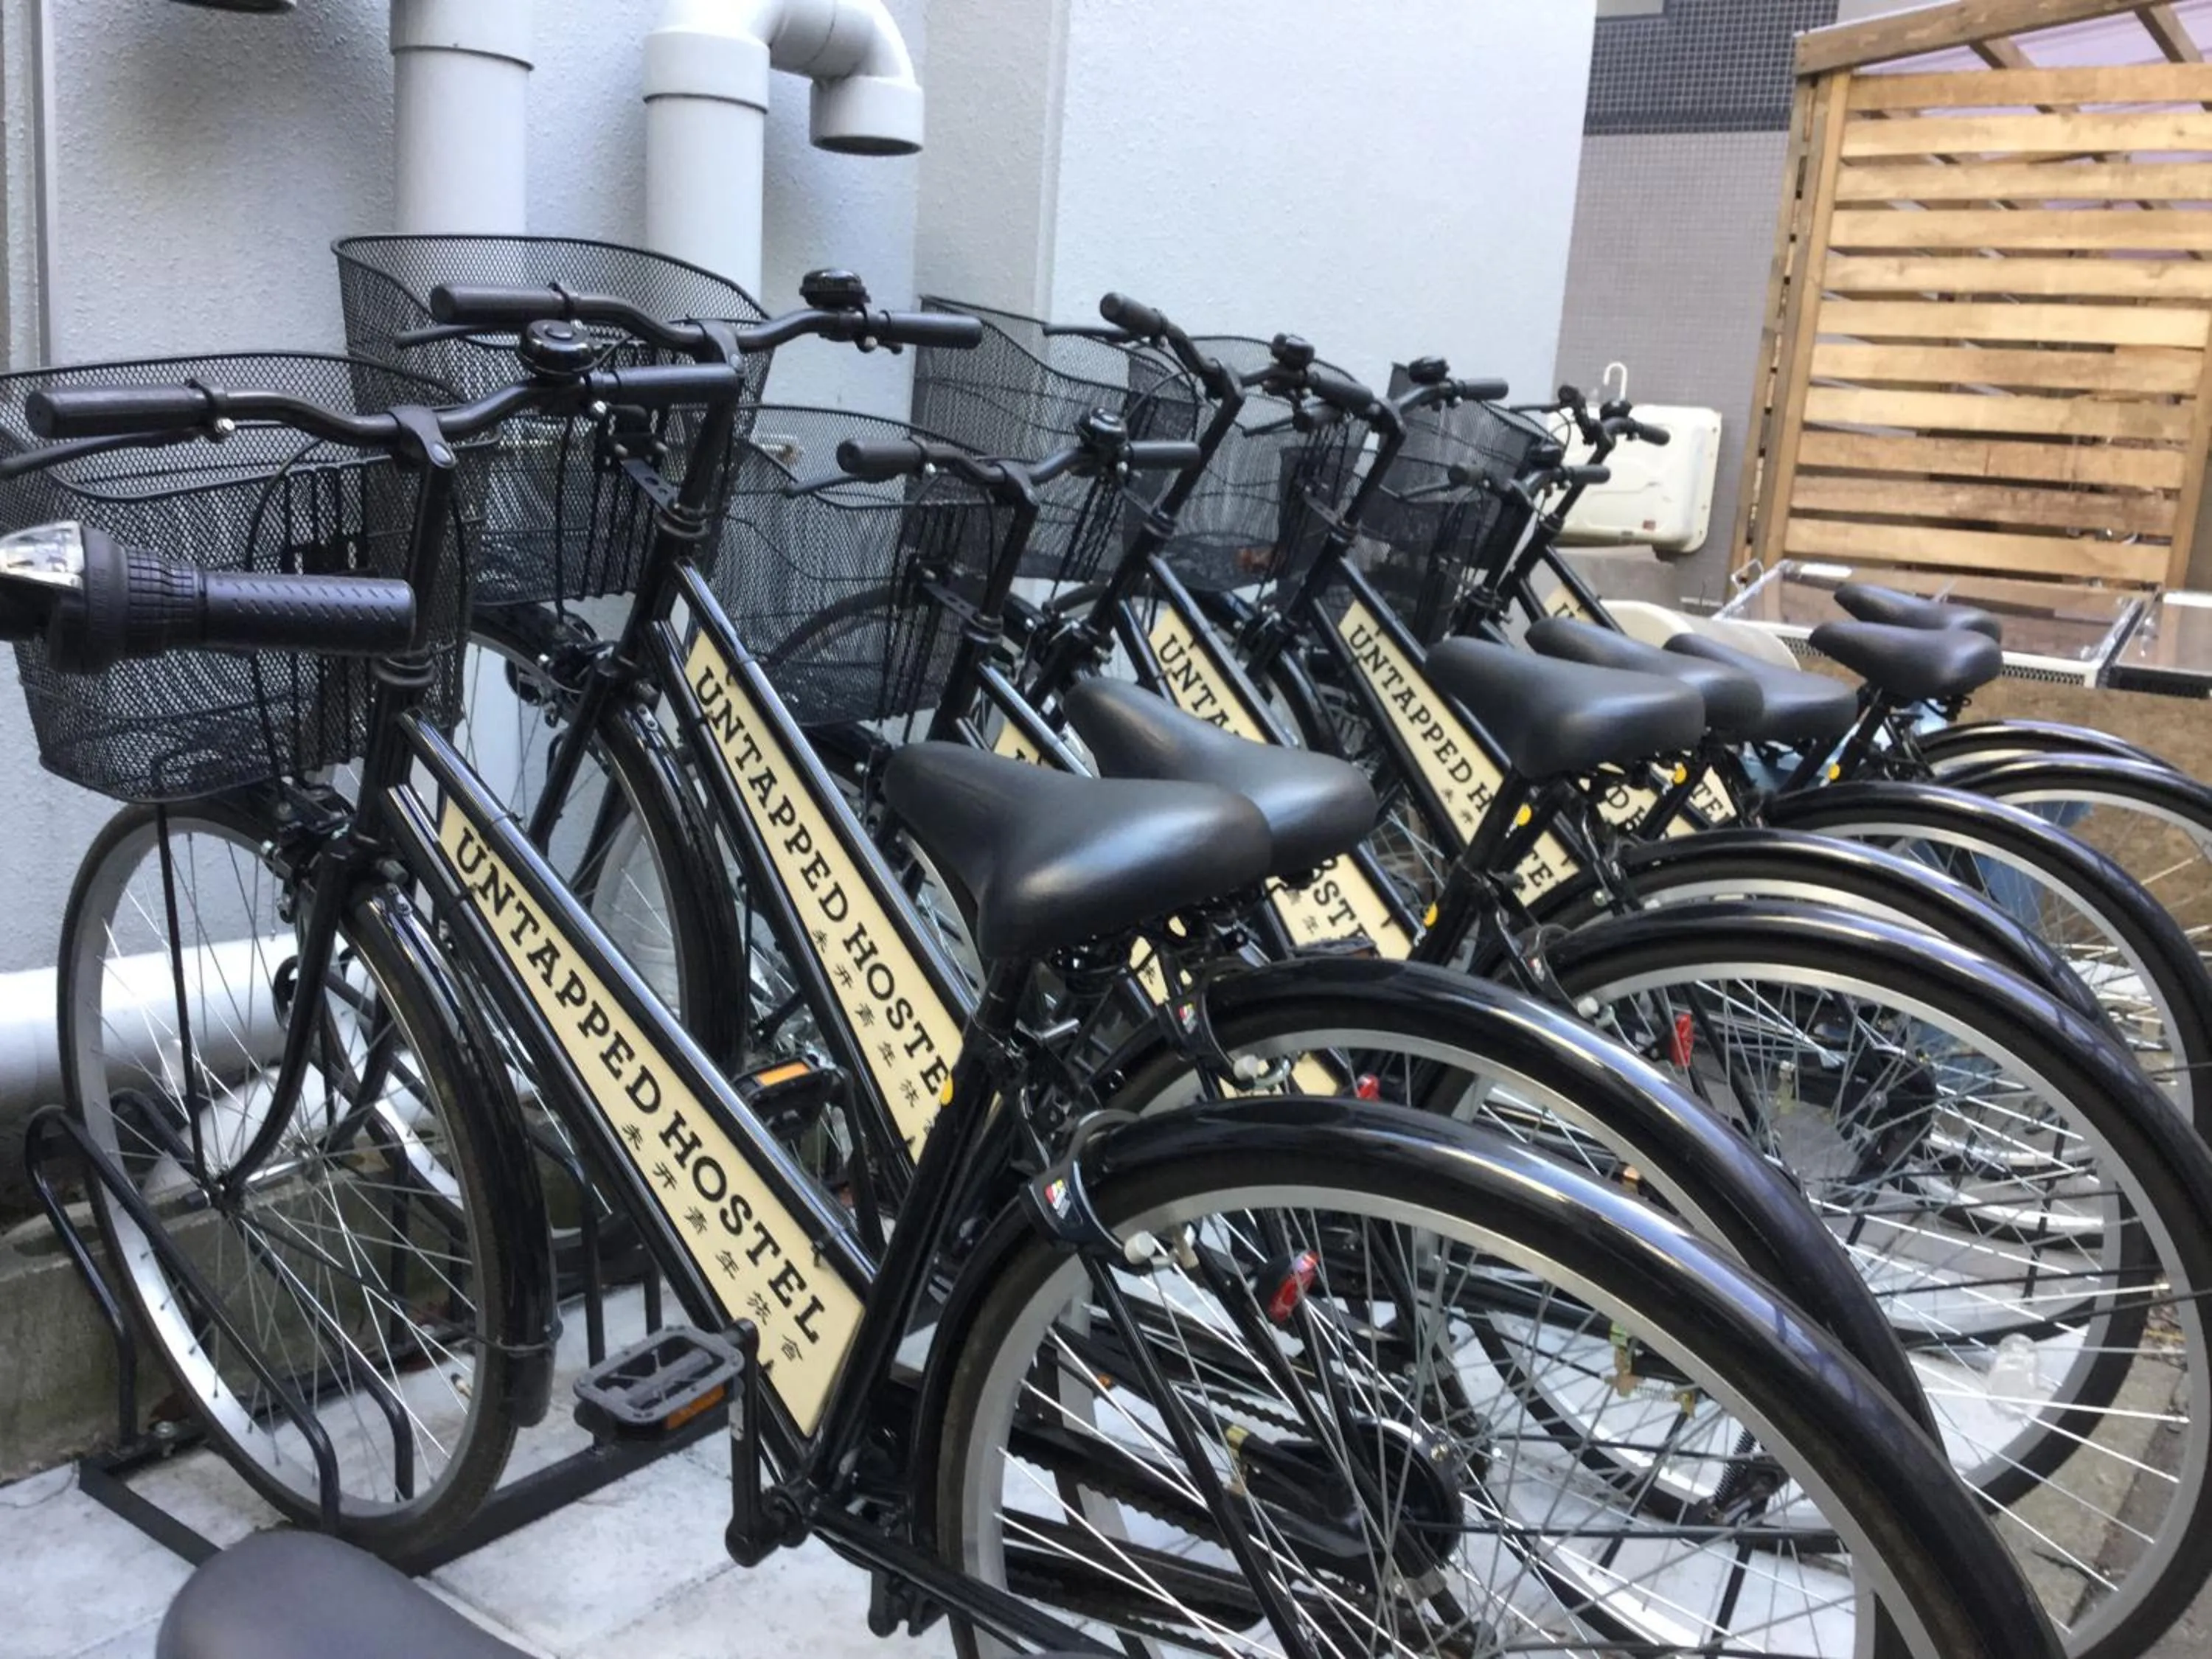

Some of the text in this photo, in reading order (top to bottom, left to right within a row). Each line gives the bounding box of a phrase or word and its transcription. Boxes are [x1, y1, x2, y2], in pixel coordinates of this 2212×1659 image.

[1159, 633, 1239, 735] UNTA
[1335, 625, 1473, 784] UNTAPPED
[696, 668, 952, 1097] UNTAPPED HOSTE
[454, 832, 824, 1344] UNTAPPED HOSTEL
